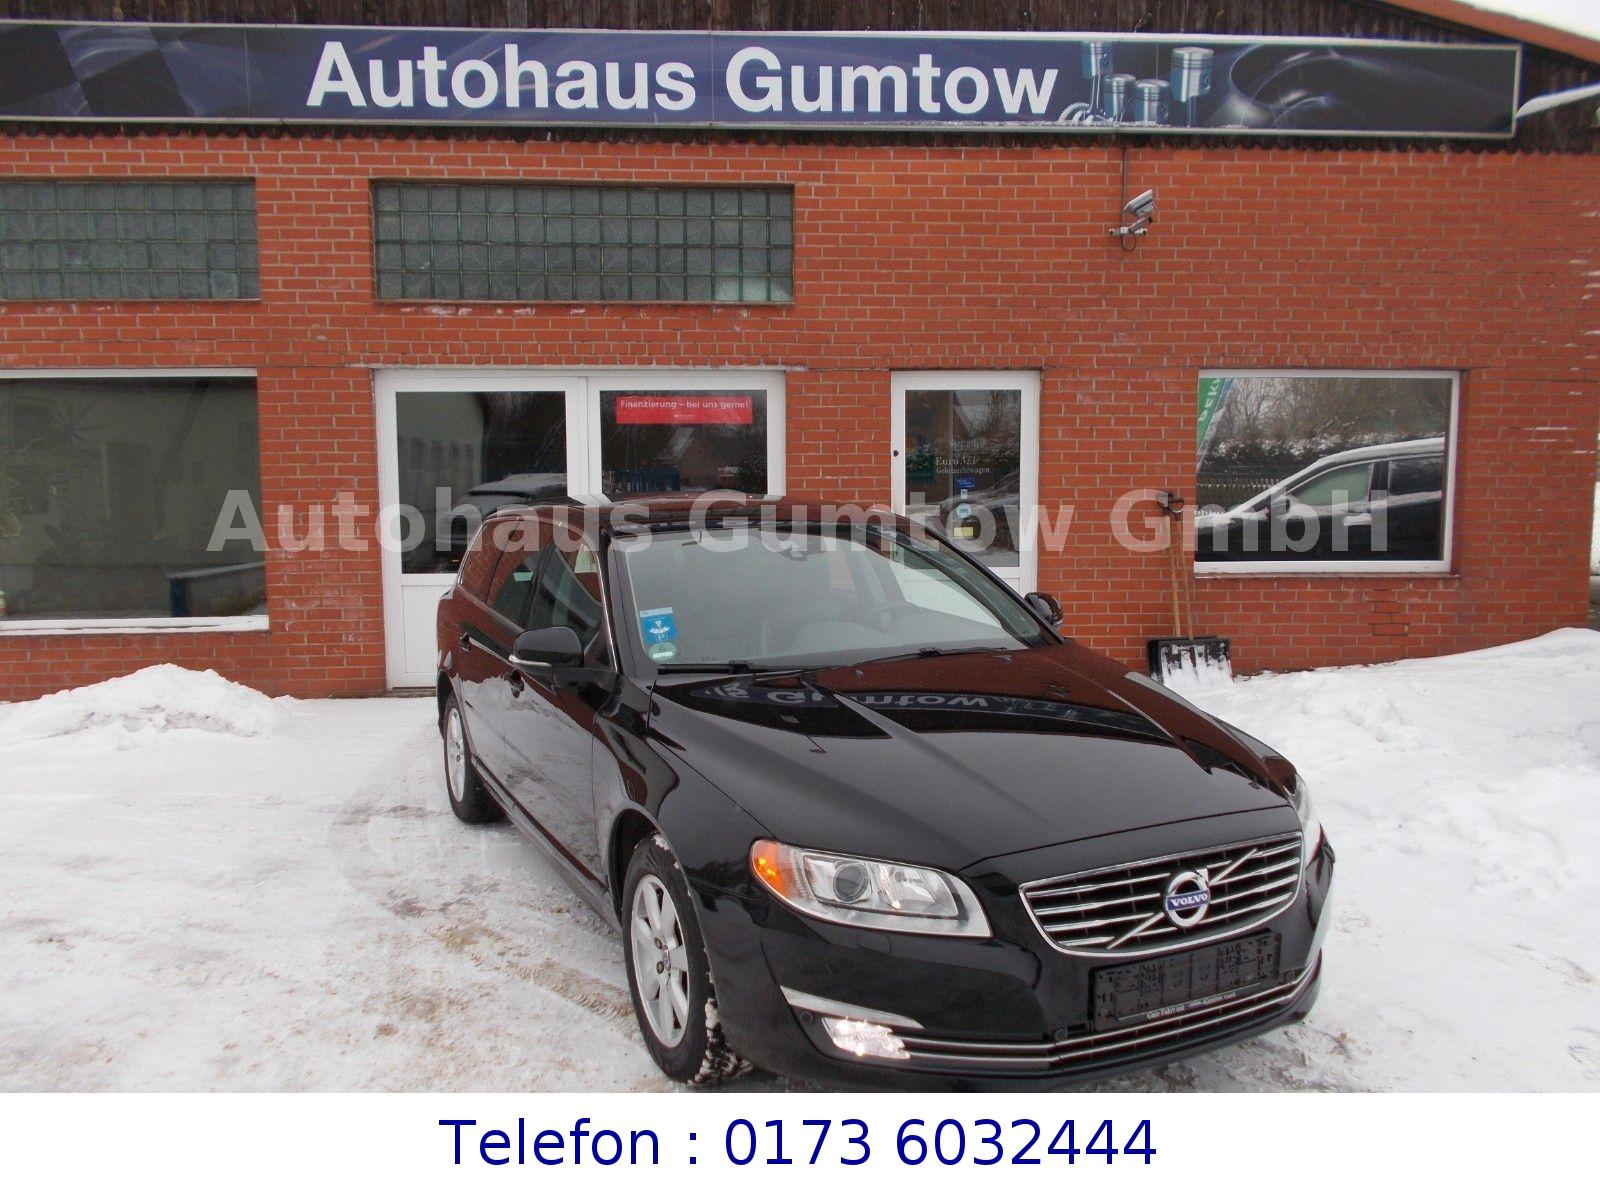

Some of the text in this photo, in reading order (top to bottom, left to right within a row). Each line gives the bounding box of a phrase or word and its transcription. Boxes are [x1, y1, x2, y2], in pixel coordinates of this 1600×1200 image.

[307, 42, 1058, 114] Autohaus Gumtow
[620, 400, 677, 409] Finanzierung
[687, 400, 700, 408] bei
[1170, 893, 1208, 907] VOLVO
